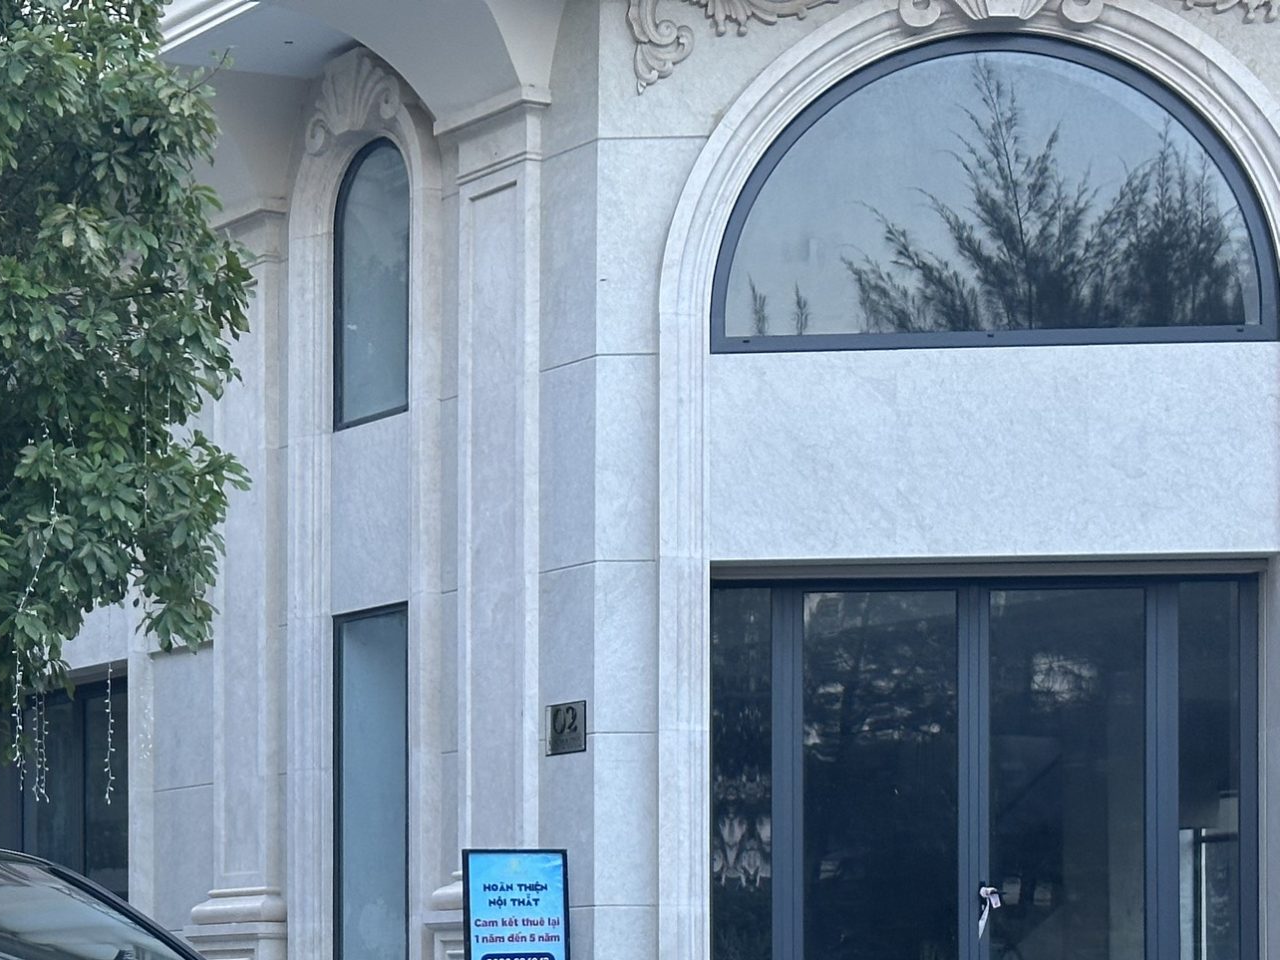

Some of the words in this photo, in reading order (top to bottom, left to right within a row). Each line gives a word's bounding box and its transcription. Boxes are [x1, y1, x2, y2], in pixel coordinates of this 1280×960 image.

[553, 706, 578, 734] 02
[483, 881, 513, 892] HOÀN
[517, 881, 548, 894] THIỆN
[488, 895, 507, 909] NỘI
[510, 893, 540, 907] THẤT
[474, 918, 499, 928] Cam
[501, 915, 518, 927] kết
[522, 916, 545, 927] thuê
[548, 917, 560, 929] lại
[474, 934, 479, 944] 1
[481, 933, 505, 944] năm
[507, 931, 527, 943] đến
[529, 934, 536, 943] 5
[538, 932, 561, 943] năm
